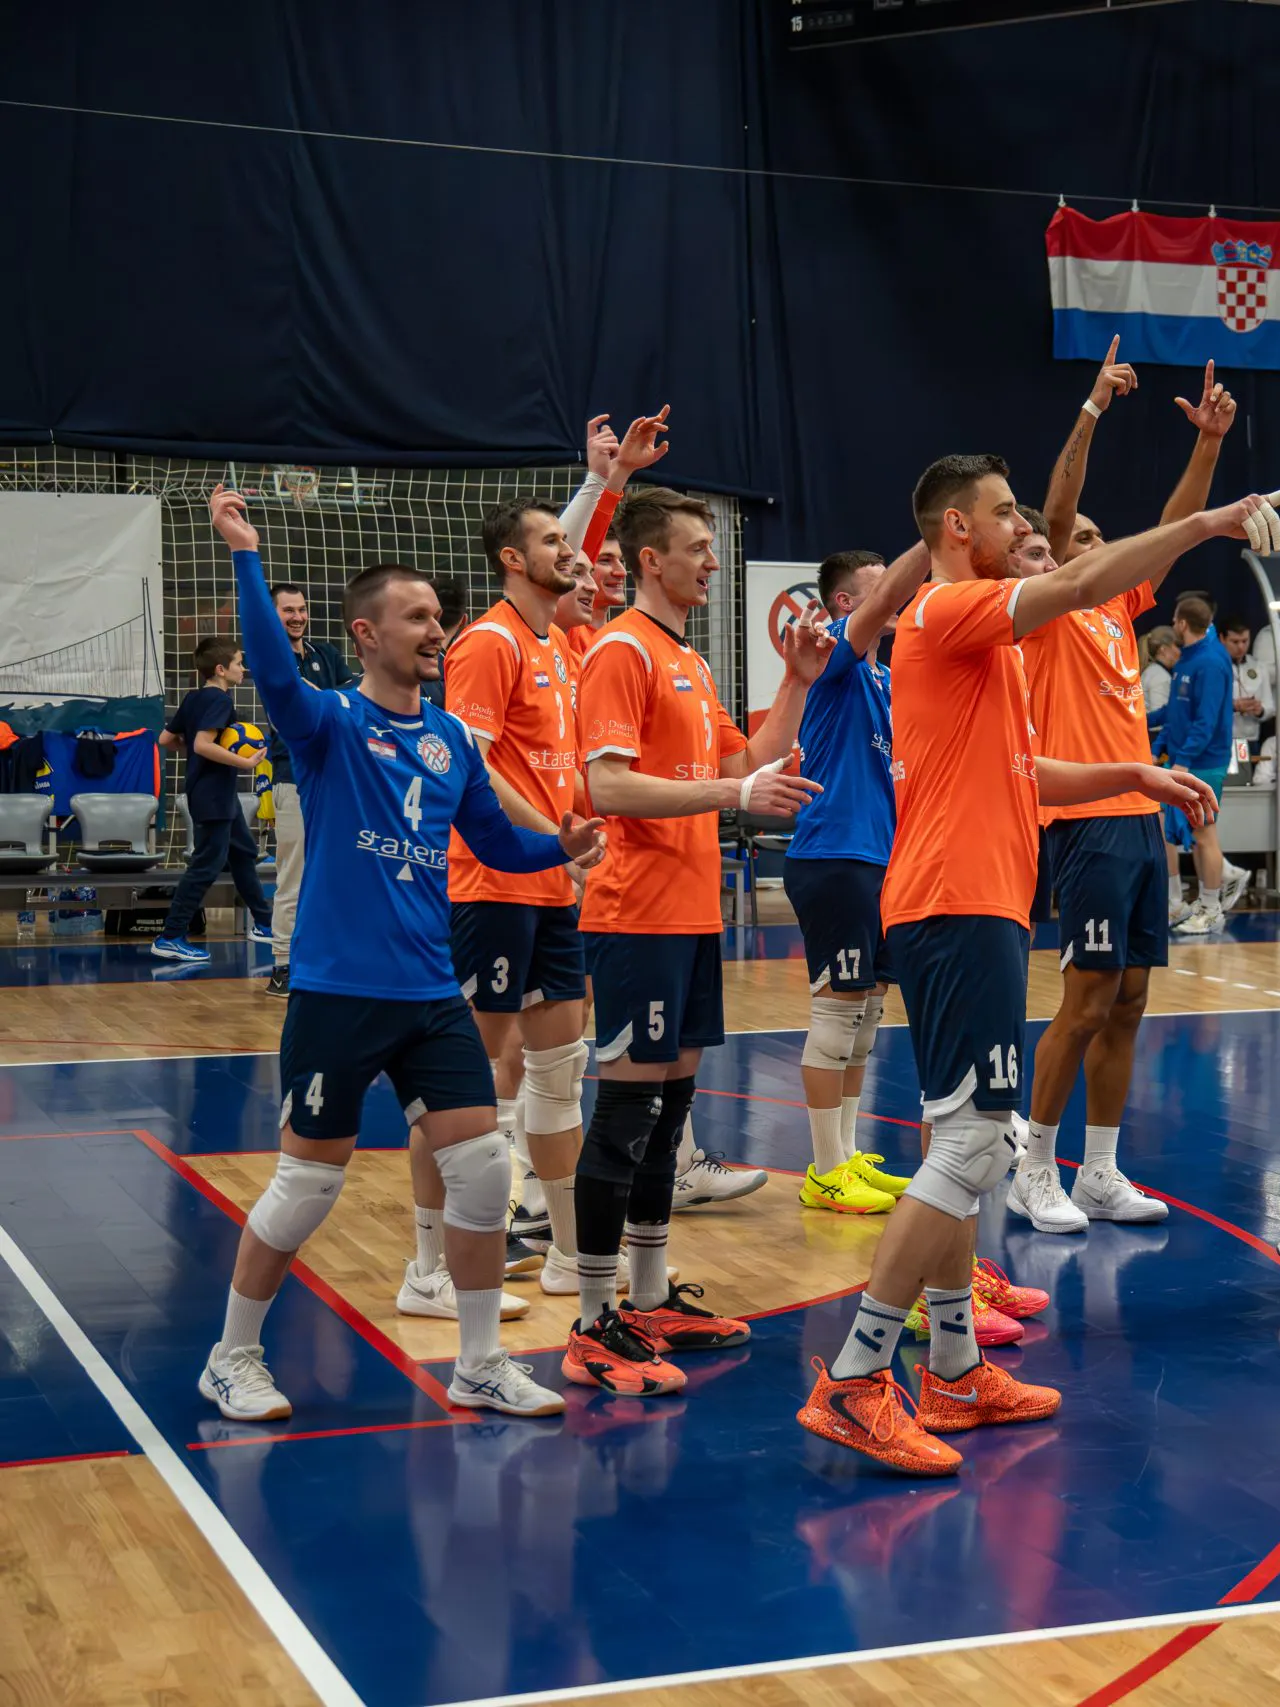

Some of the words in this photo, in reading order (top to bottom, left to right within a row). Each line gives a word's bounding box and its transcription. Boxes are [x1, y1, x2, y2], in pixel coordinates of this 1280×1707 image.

[791, 16, 803, 32] 15
[404, 776, 423, 832] 4
[356, 829, 448, 868] statera
[1085, 918, 1112, 952] 11
[491, 956, 509, 994] 3
[836, 948, 861, 981] 17
[648, 1000, 665, 1042] 5
[988, 1044, 1019, 1090] 16
[304, 1072, 324, 1116] 4
